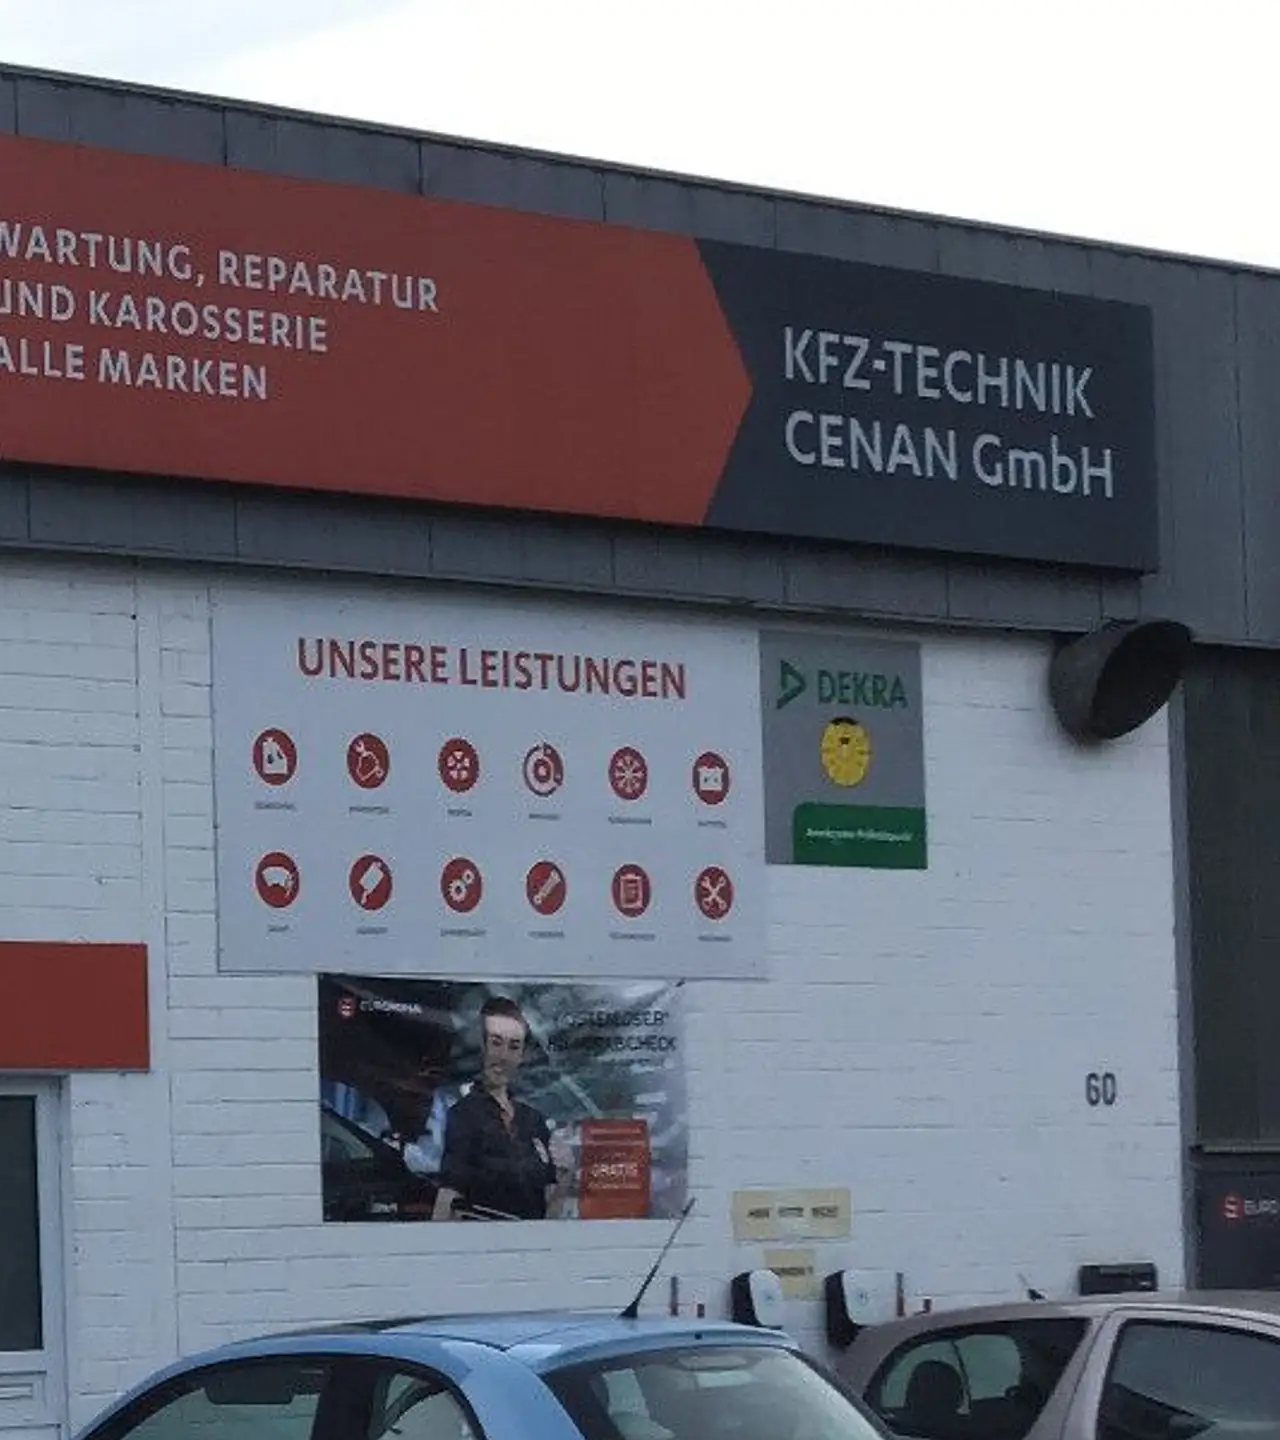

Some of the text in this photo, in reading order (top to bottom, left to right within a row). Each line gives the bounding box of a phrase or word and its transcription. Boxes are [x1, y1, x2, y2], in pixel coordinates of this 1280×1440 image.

[219, 251, 440, 312] REPARATUR
[89, 290, 328, 352] KAROSSERIE
[99, 348, 268, 400] MARKEN
[783, 326, 1093, 418] KFZ-TECHNIK
[784, 410, 1114, 498] CENAN GmbH
[298, 637, 686, 700] UNSERE LEISTUNGEN
[816, 668, 908, 710] DEKRA
[1086, 1072, 1117, 1106] 60
